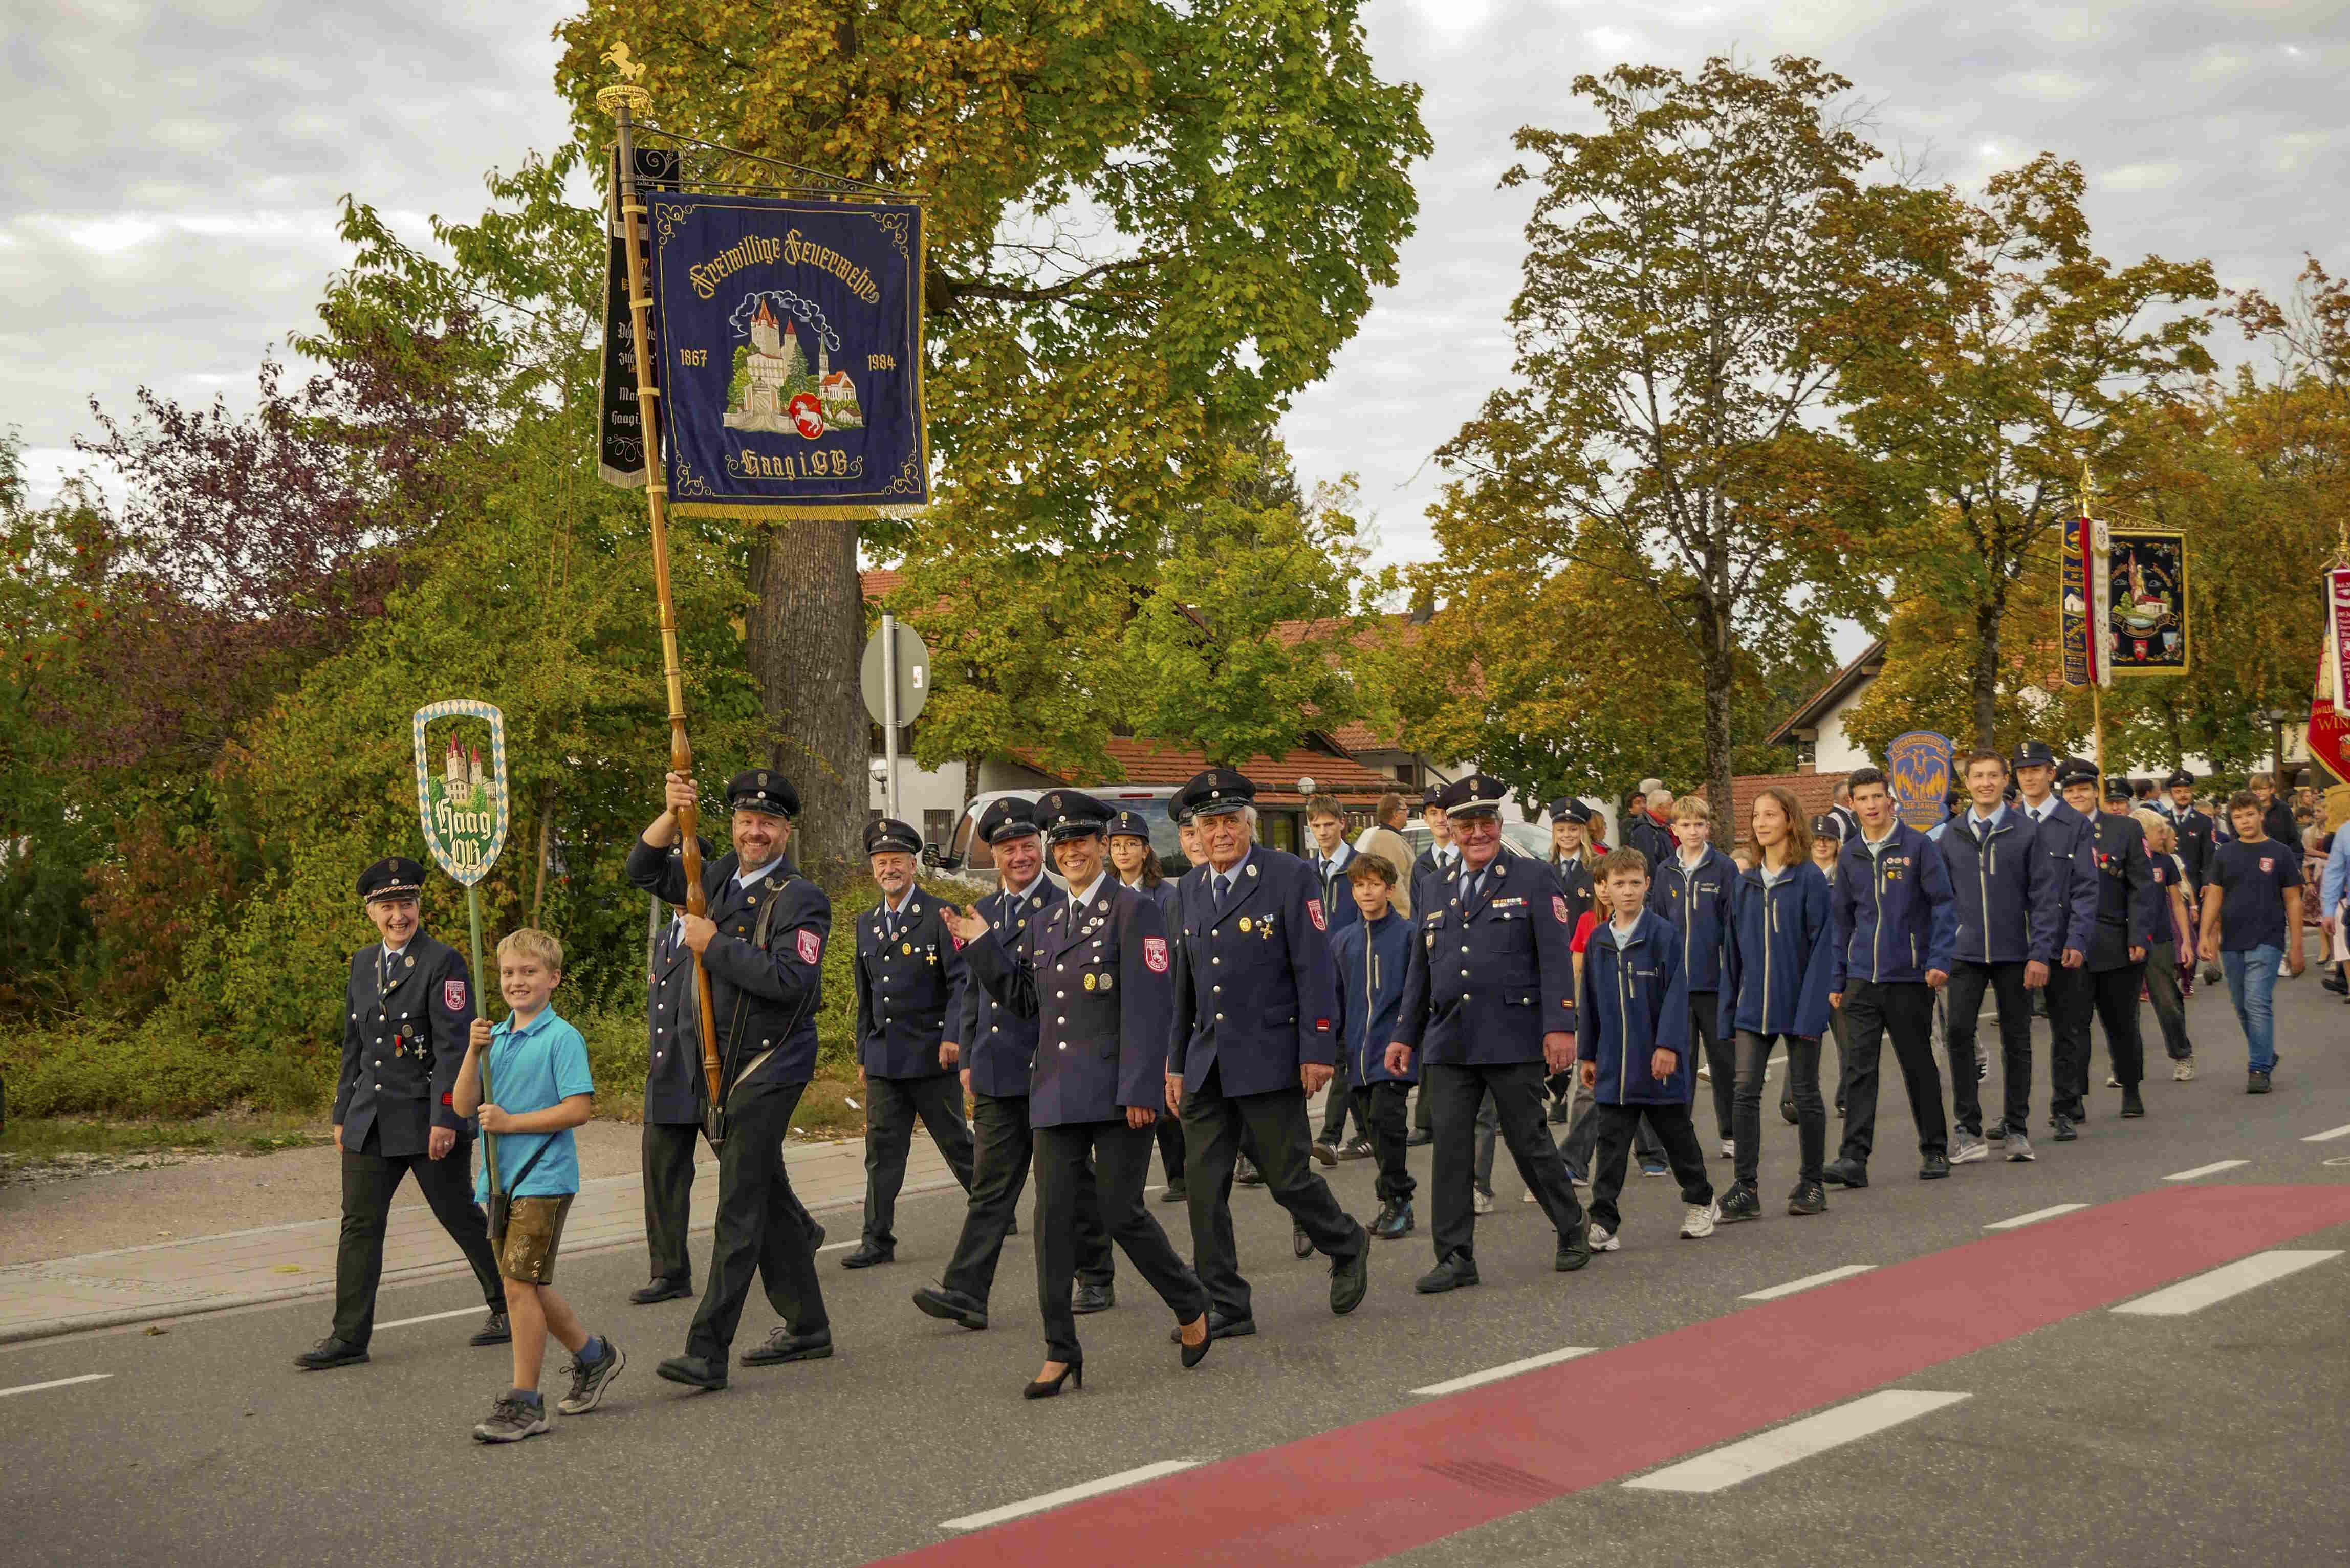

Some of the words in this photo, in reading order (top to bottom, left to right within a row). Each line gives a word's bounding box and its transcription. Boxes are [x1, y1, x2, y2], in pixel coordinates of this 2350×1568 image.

[690, 234, 781, 299] Freiwillige
[784, 229, 880, 304] Feuerwehr
[679, 348, 708, 368] 1867
[867, 354, 897, 372] 1984
[741, 449, 796, 481] Haag
[436, 798, 491, 843] Haag
[451, 838, 481, 870] OB
